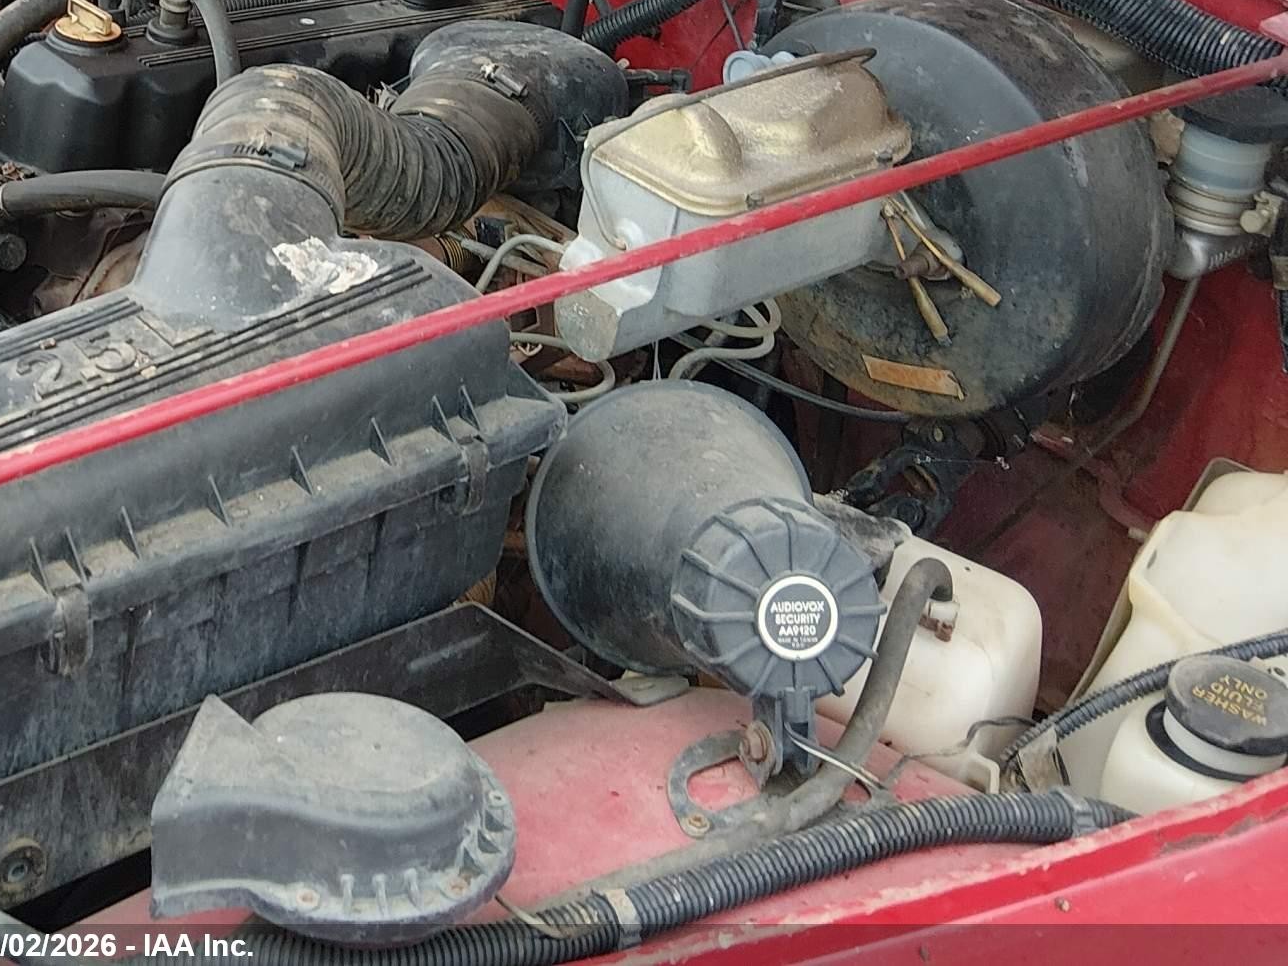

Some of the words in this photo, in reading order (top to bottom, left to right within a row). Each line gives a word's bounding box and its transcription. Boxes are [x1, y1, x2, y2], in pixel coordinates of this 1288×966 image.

[771, 601, 824, 613] AUDIOVOX
[775, 613, 821, 625] SECURITY
[778, 625, 817, 636] AA9120
[1219, 674, 1268, 700] ONLY
[1192, 686, 1267, 726] WASHER
